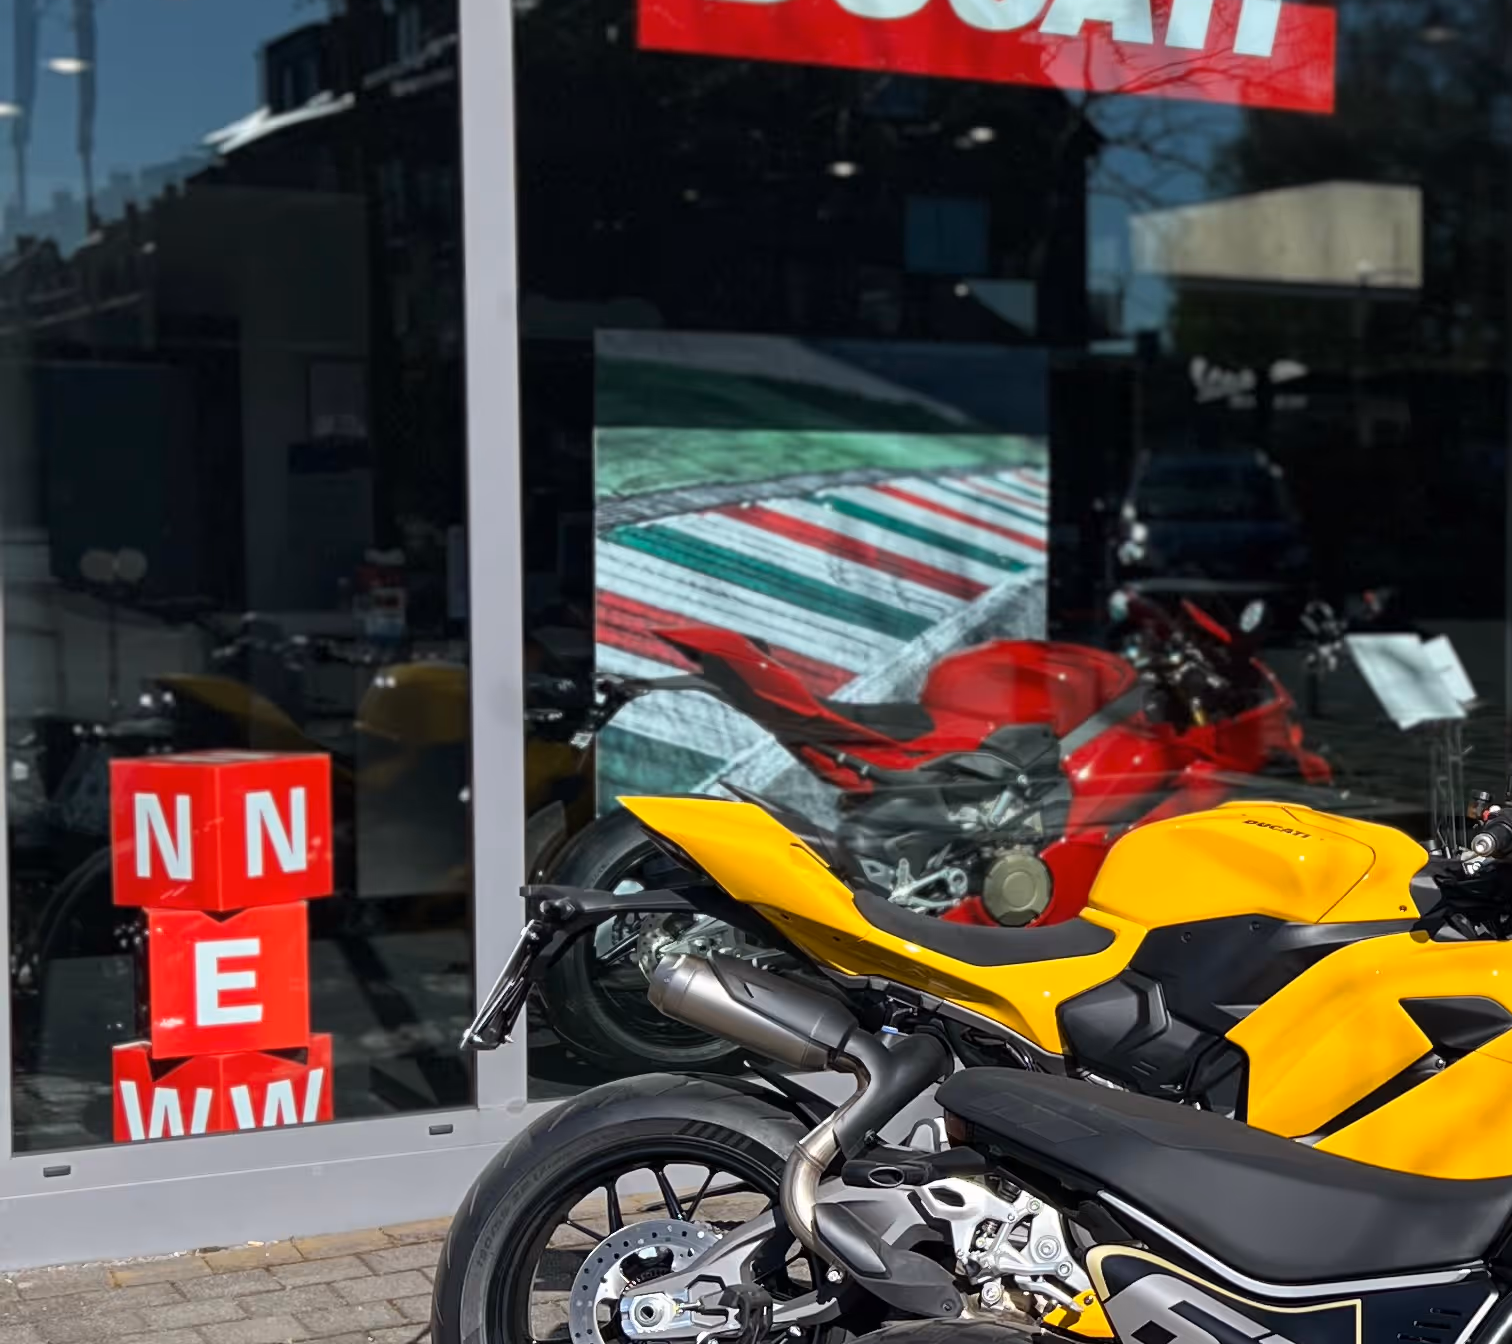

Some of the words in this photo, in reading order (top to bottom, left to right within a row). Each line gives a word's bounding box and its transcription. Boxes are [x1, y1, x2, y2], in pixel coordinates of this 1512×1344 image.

[134, 792, 194, 881] N
[245, 786, 307, 879] N
[1242, 819, 1312, 839] DUCATI
[194, 938, 263, 1027] E
